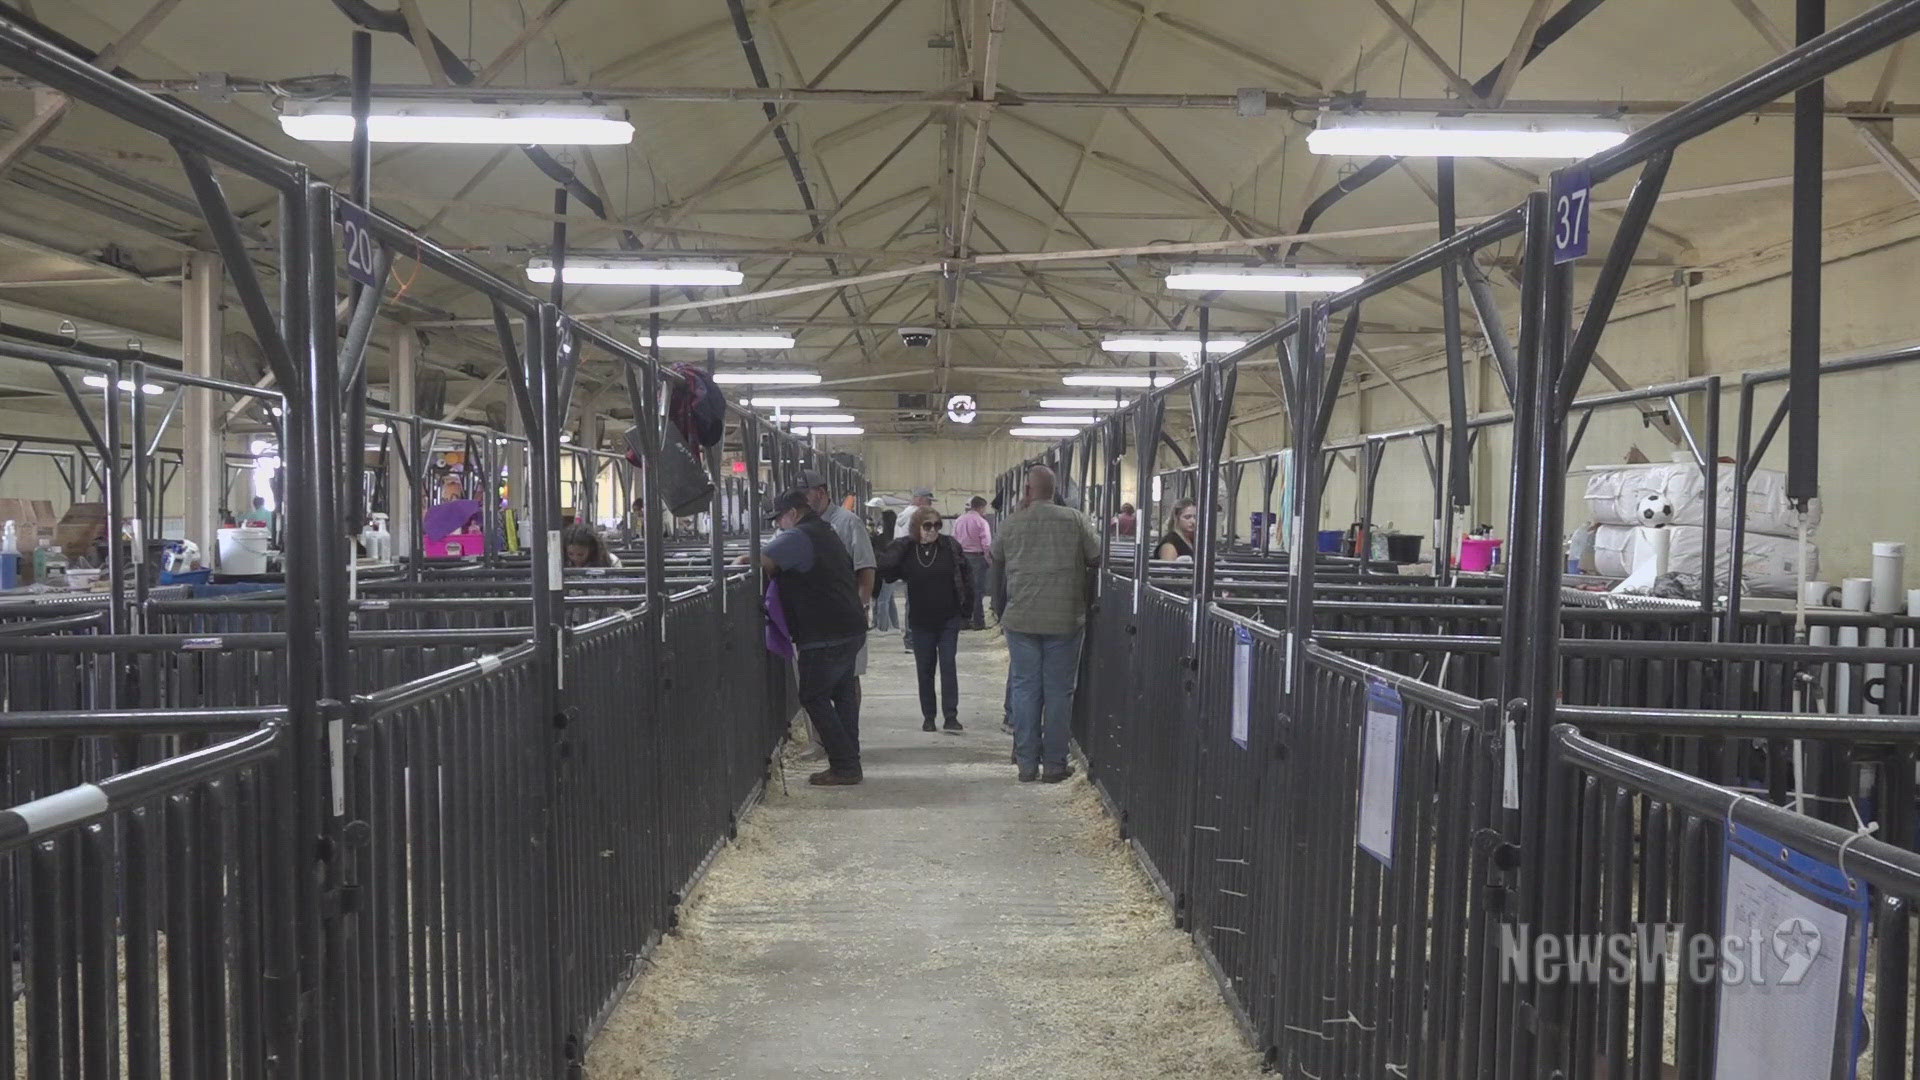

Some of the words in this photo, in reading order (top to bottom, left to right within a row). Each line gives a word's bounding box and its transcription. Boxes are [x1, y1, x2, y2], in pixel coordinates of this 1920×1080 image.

[1556, 188, 1587, 250] 37
[345, 220, 373, 275] 20
[1315, 314, 1328, 353] 38
